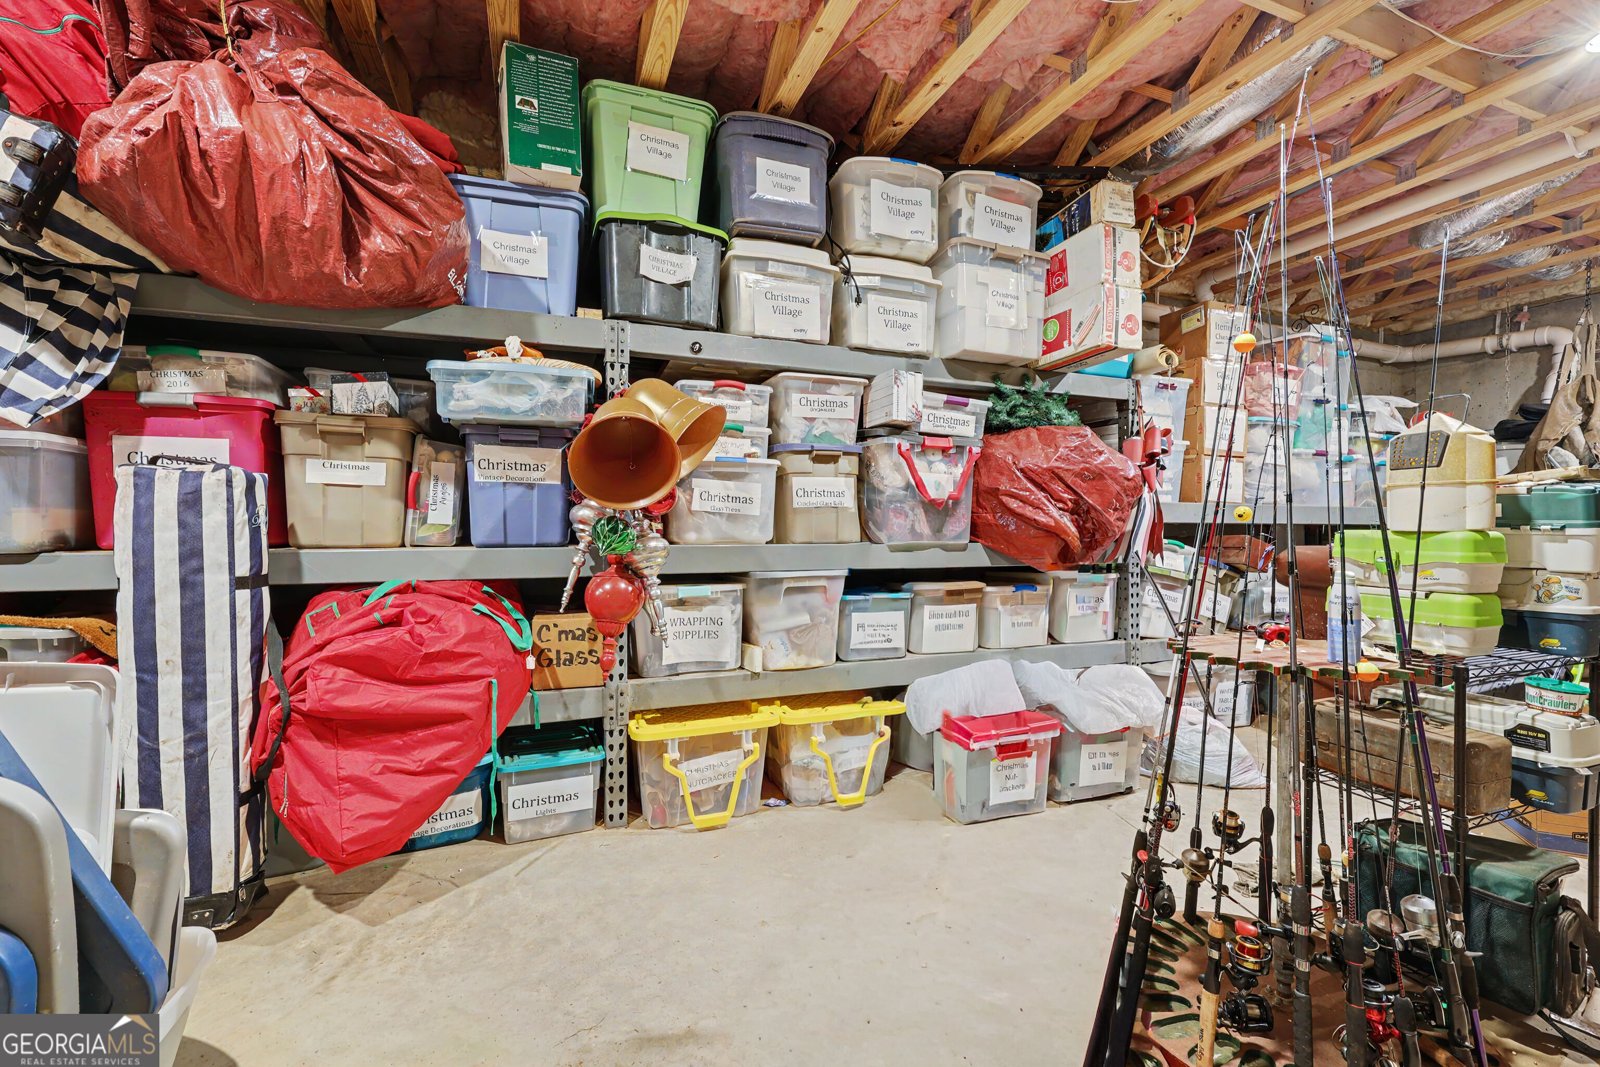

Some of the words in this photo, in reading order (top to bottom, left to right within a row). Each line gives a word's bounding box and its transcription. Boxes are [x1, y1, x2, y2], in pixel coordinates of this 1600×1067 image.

[639, 133, 680, 150] Christmas
[646, 145, 673, 160] Village
[765, 168, 802, 183] Christmas
[771, 180, 796, 193] Village
[880, 191, 923, 207] Christmas
[887, 205, 916, 219] Village
[984, 205, 1023, 223] Christmas
[989, 218, 1016, 233] Village
[492, 240, 537, 255] Christmas
[500, 254, 530, 266] Village
[648, 254, 684, 270] CHRISTMAS
[651, 263, 678, 277] VILLAGE
[764, 290, 811, 305] Christmas
[991, 289, 1020, 301] Christmas
[772, 304, 803, 318] Village
[996, 299, 1015, 310] Village
[877, 305, 918, 319] Christmas
[883, 318, 912, 331] Village
[149, 370, 204, 378] CHRISTMAS
[166, 380, 190, 388] 2016
[799, 396, 848, 408] Christmas
[927, 412, 970, 427] Christmas
[322, 460, 370, 471] Christmas
[478, 458, 547, 473] Christmas
[478, 473, 504, 481] Vintage
[505, 474, 546, 482] Decorations
[430, 474, 439, 512] Christmas
[699, 490, 754, 505] Christmas
[795, 487, 846, 498] Christmas
[669, 616, 724, 628] WRAPPING
[536, 622, 599, 643] C'mas
[672, 629, 720, 641] SUPPLIES
[536, 647, 600, 668] Glass
[685, 760, 730, 777] CHRISTMAS
[995, 762, 1029, 773] Christmas
[511, 790, 580, 810] Christmas
[426, 804, 473, 825] istmas
[535, 806, 557, 817] Lights
[430, 818, 475, 834] Decorations
